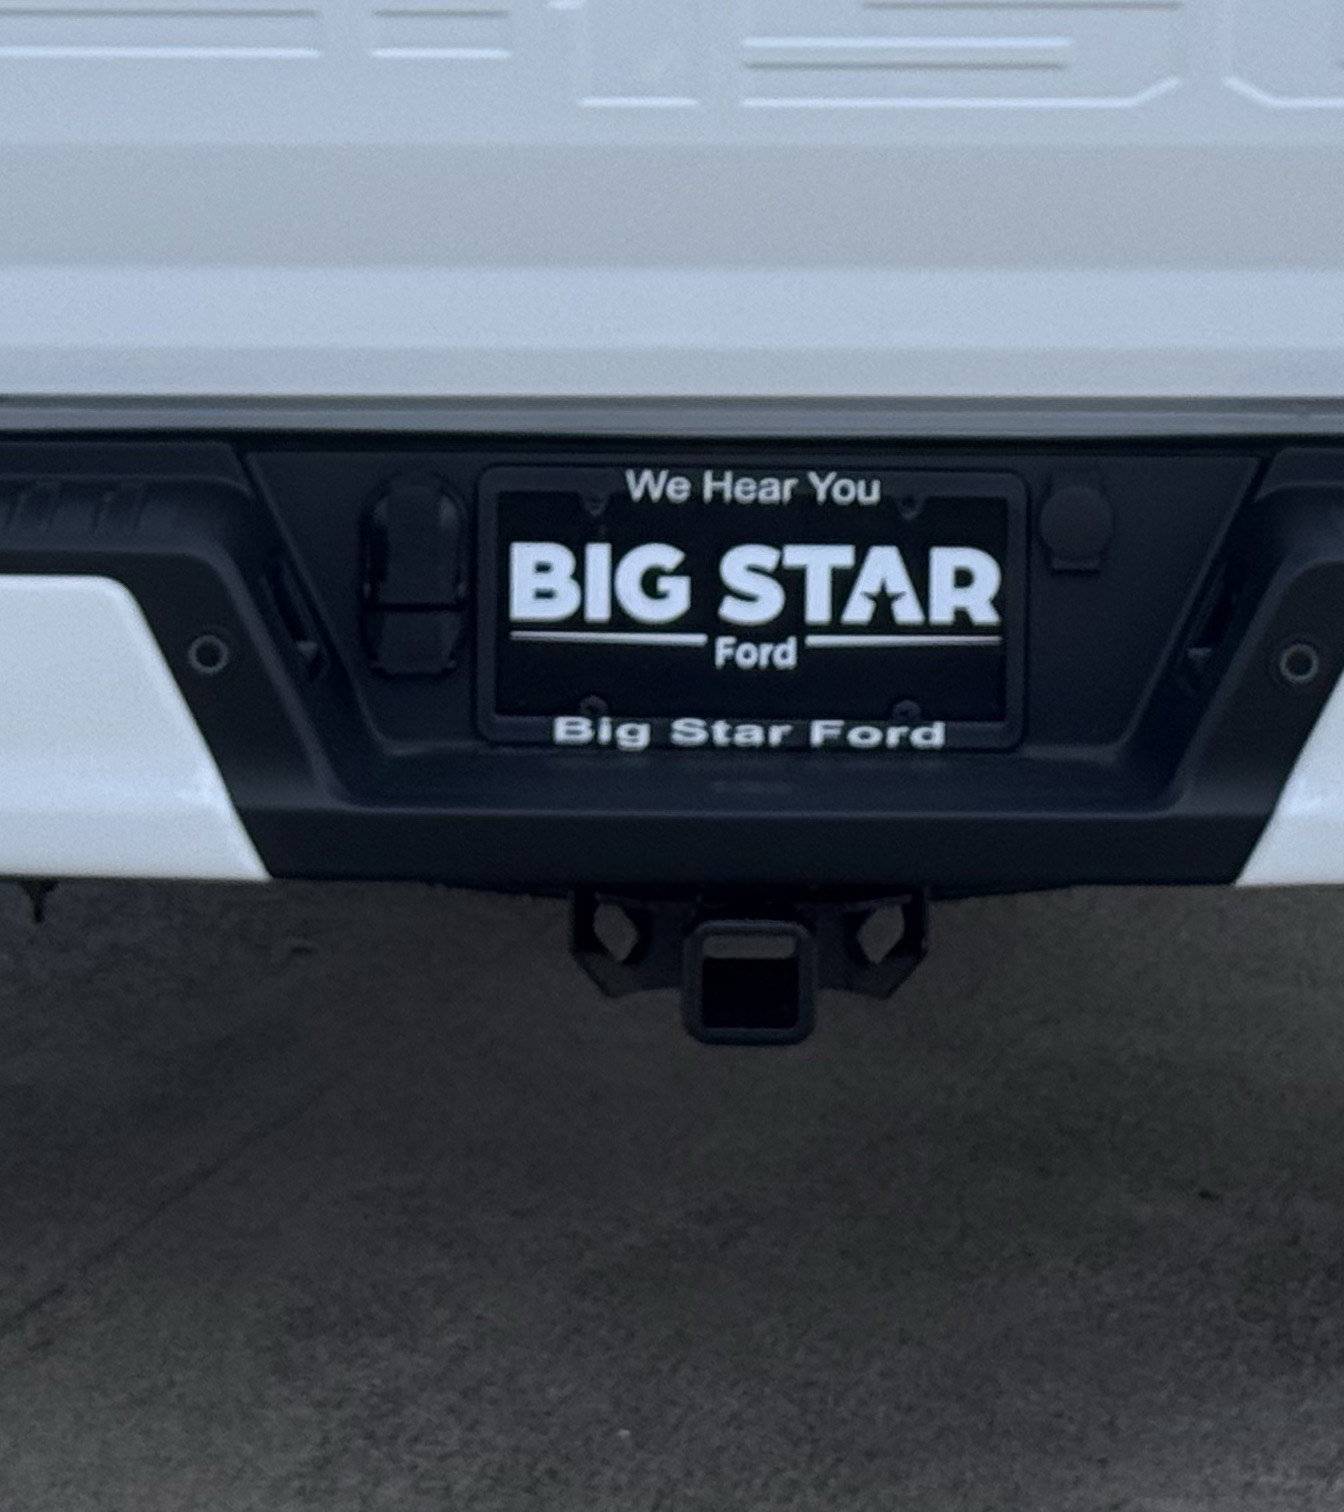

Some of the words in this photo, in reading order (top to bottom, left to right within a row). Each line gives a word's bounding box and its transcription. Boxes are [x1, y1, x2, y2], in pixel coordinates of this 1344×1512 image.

[624, 468, 692, 504] We
[702, 469, 799, 505] Hear
[806, 471, 882, 506] You
[508, 540, 693, 625] BIG
[717, 542, 1004, 627] STAR
[713, 635, 799, 670] Ford
[552, 715, 652, 751] Big
[669, 716, 793, 748] Star
[809, 719, 947, 750] Ford
